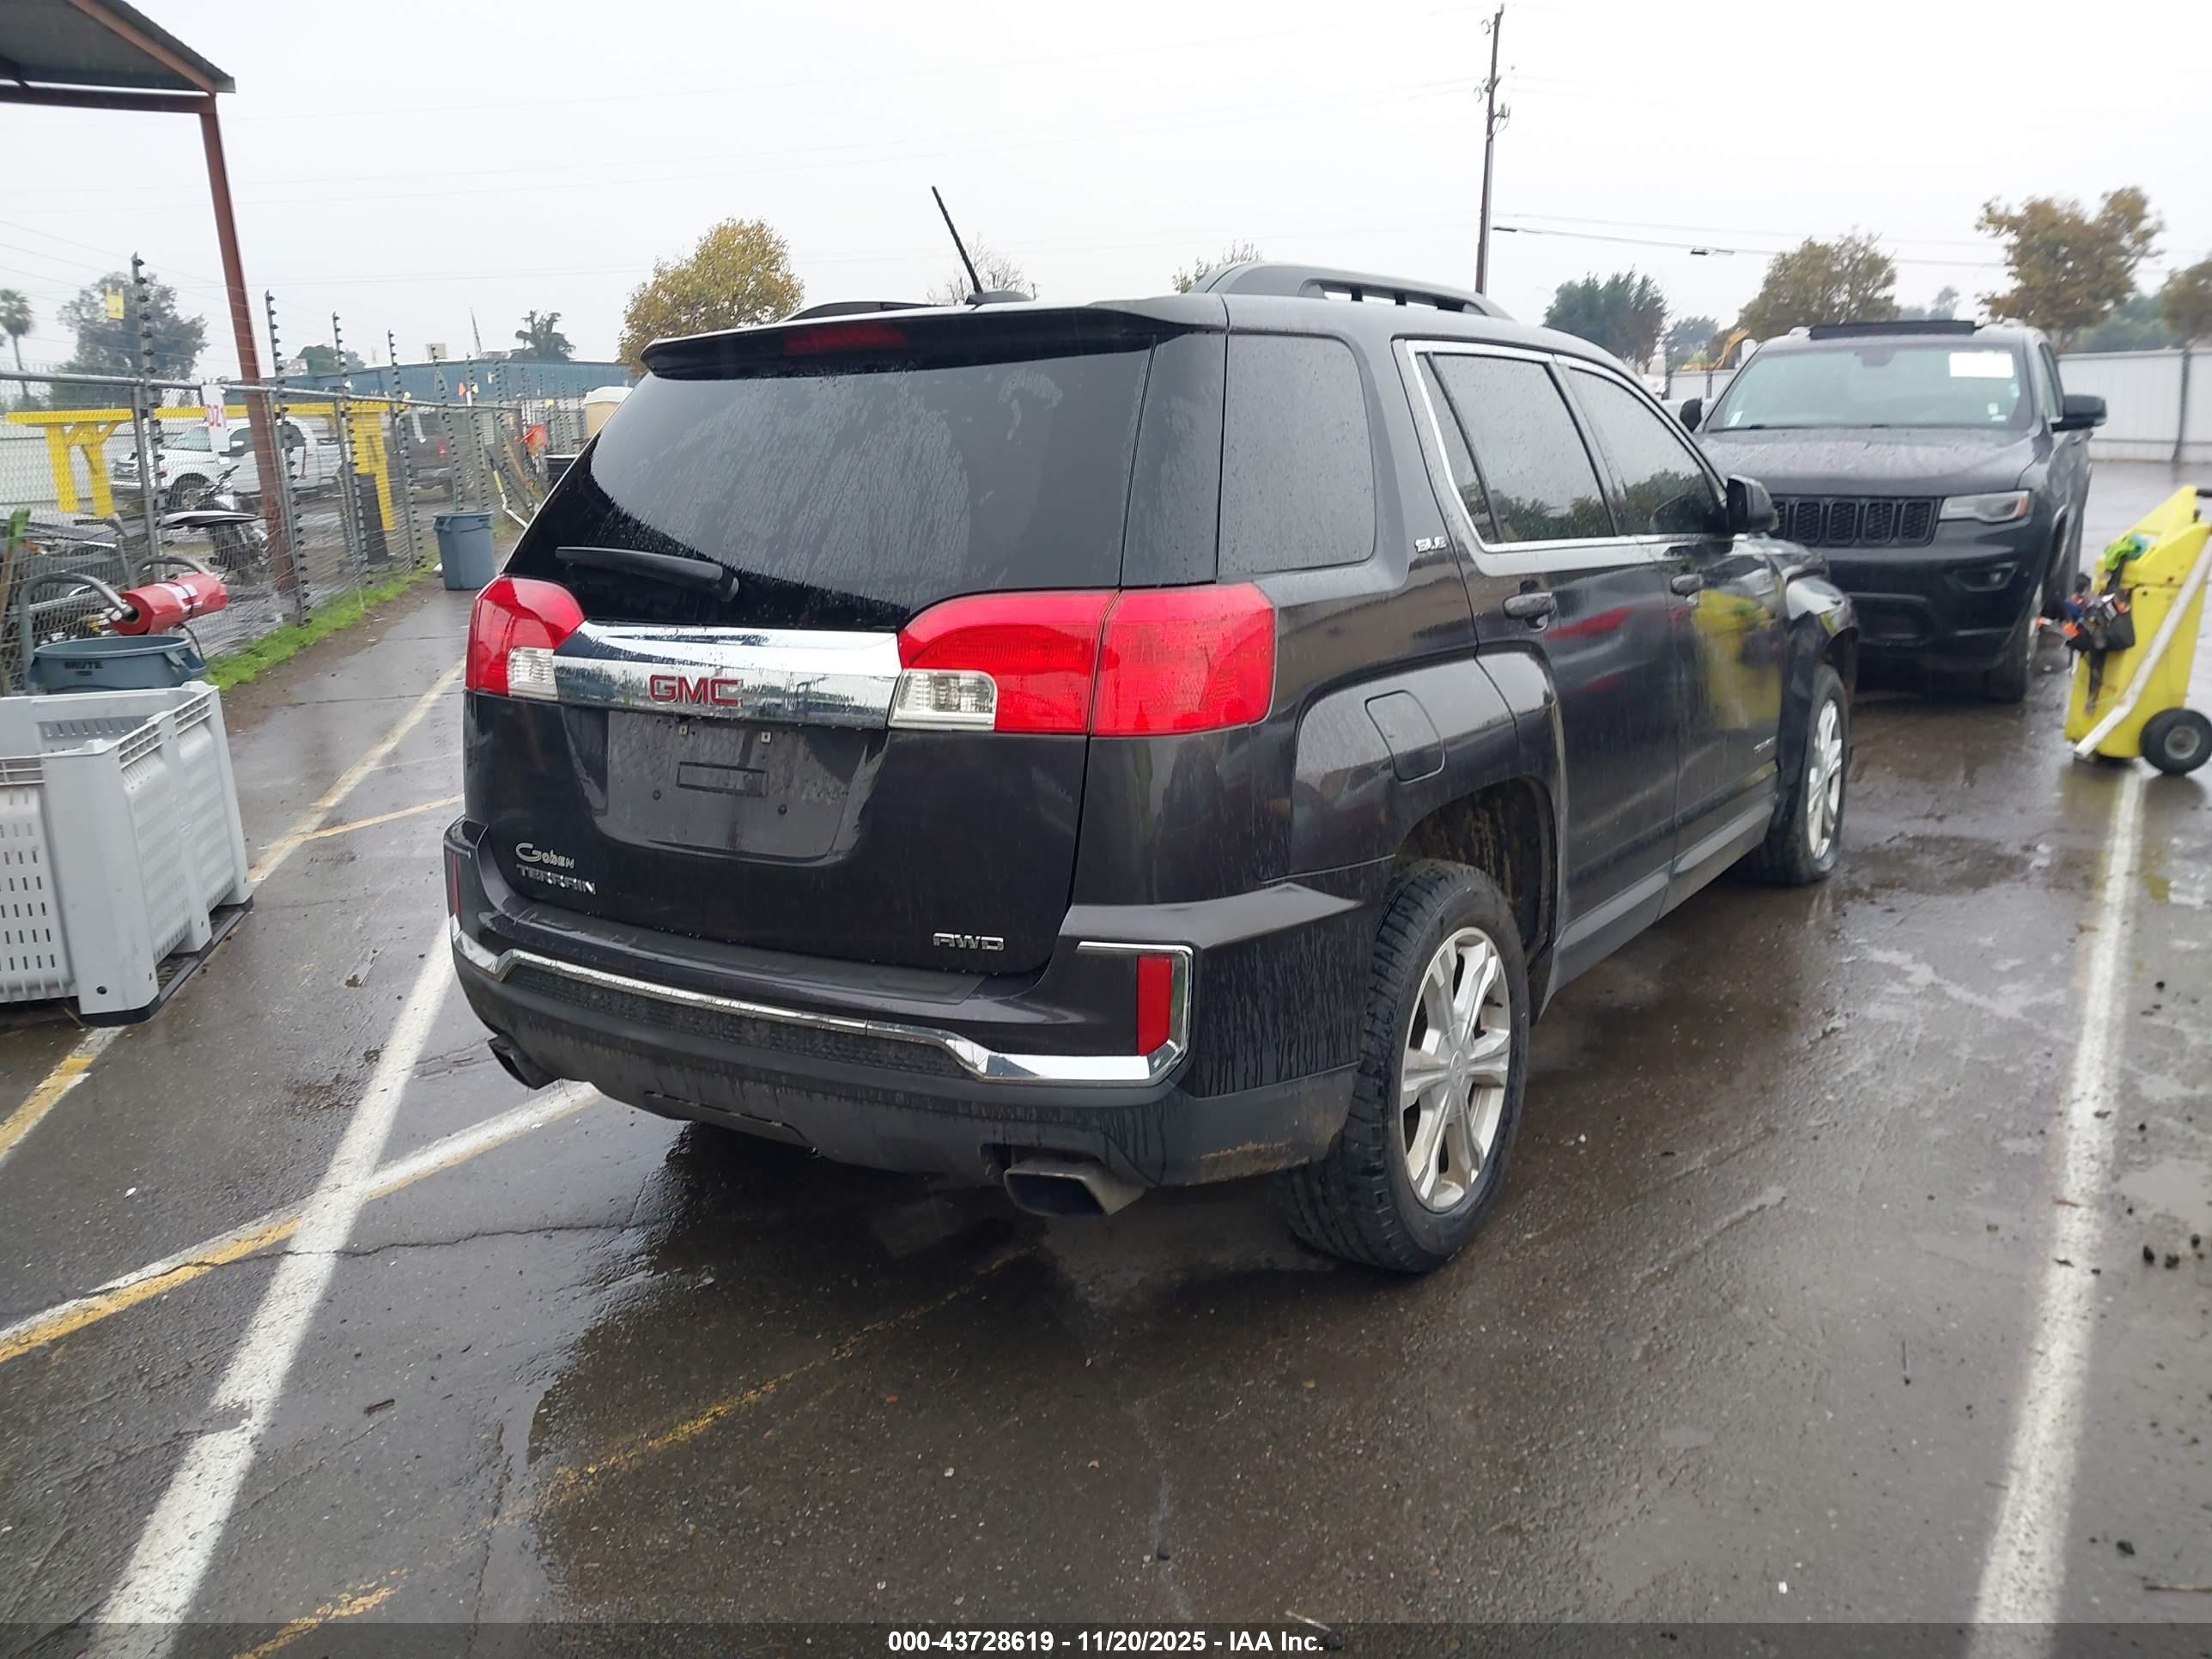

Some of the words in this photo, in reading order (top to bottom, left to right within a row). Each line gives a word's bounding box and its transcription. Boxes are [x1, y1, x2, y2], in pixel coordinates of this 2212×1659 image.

[648, 673, 744, 709] GMC
[515, 863, 597, 895] TERRAIN
[933, 932, 1005, 951] AWD
